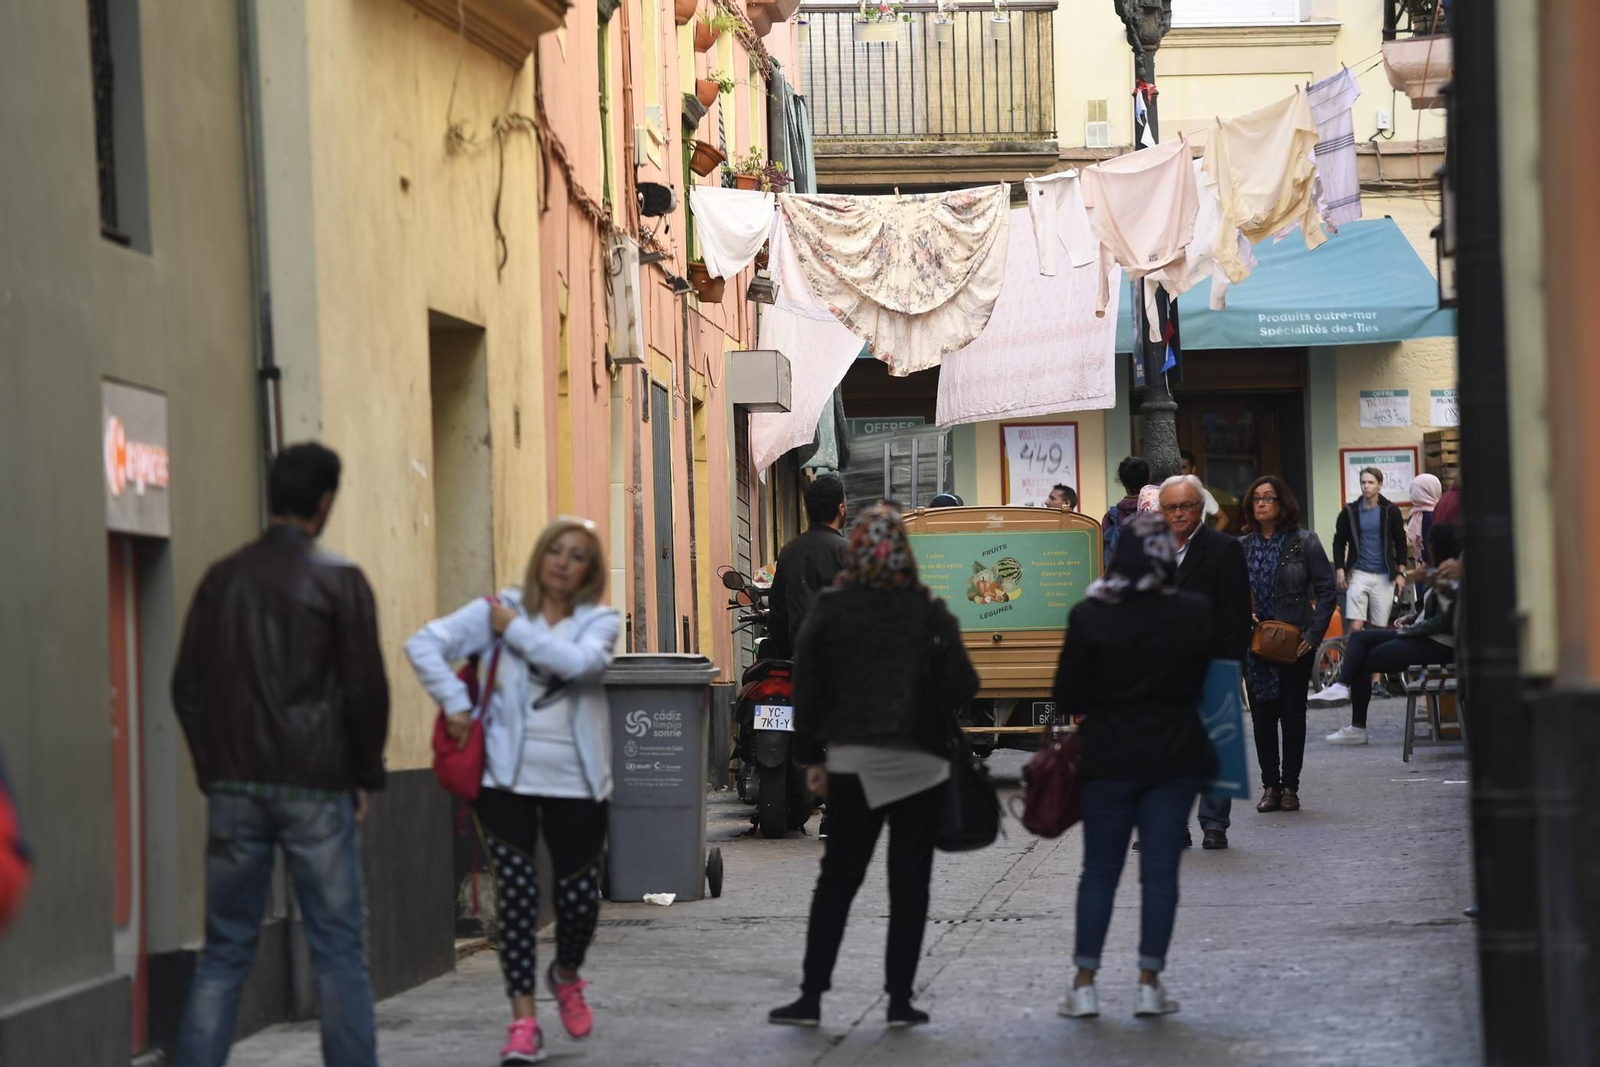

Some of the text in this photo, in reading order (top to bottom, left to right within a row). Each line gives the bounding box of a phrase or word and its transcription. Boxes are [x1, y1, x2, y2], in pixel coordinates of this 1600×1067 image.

[1258, 311, 1378, 323] Produits outre-mer
[1260, 324, 1329, 337] Spécialités
[1331, 323, 1355, 334] des
[982, 543, 1008, 557] FRUITS
[980, 604, 1014, 620] LÉGUMES
[653, 710, 682, 721] cádiz
[761, 717, 790, 729] 7K1-Y
[653, 728, 682, 737] sonríe
